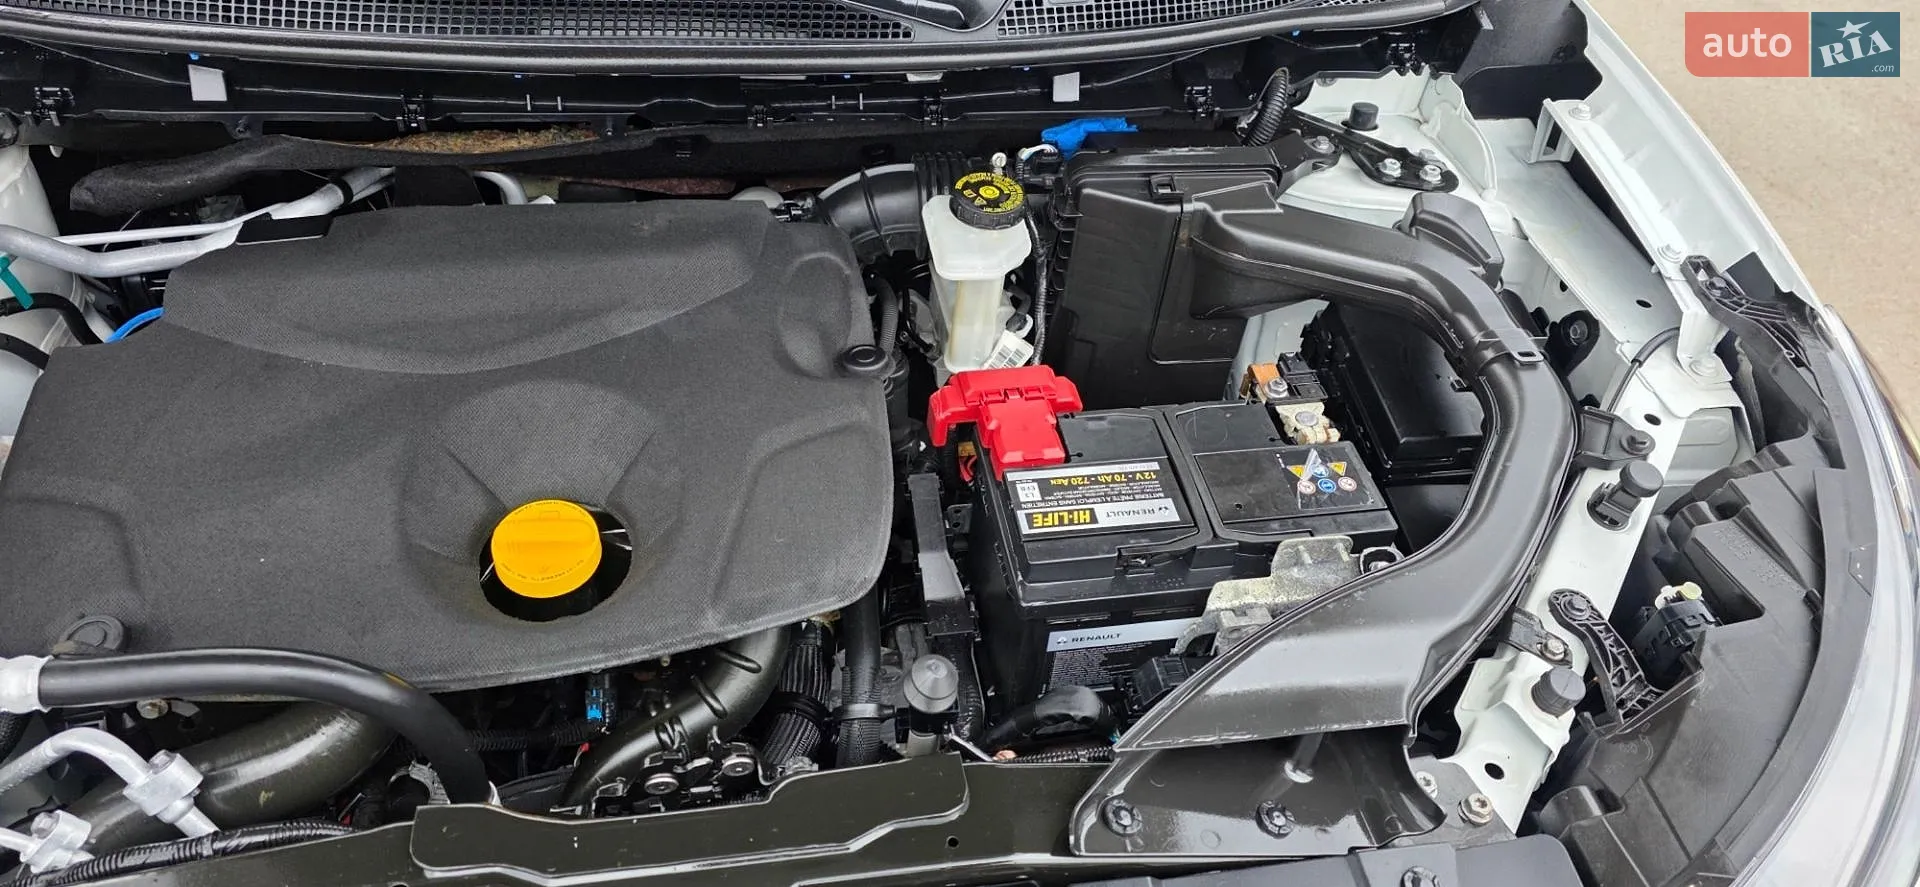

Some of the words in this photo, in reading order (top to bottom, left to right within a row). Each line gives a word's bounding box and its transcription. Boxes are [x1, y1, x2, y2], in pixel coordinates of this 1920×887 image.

[1071, 476, 1090, 485] 720
[1105, 508, 1155, 518] RENAULT
[1071, 633, 1121, 643] RENAULT
